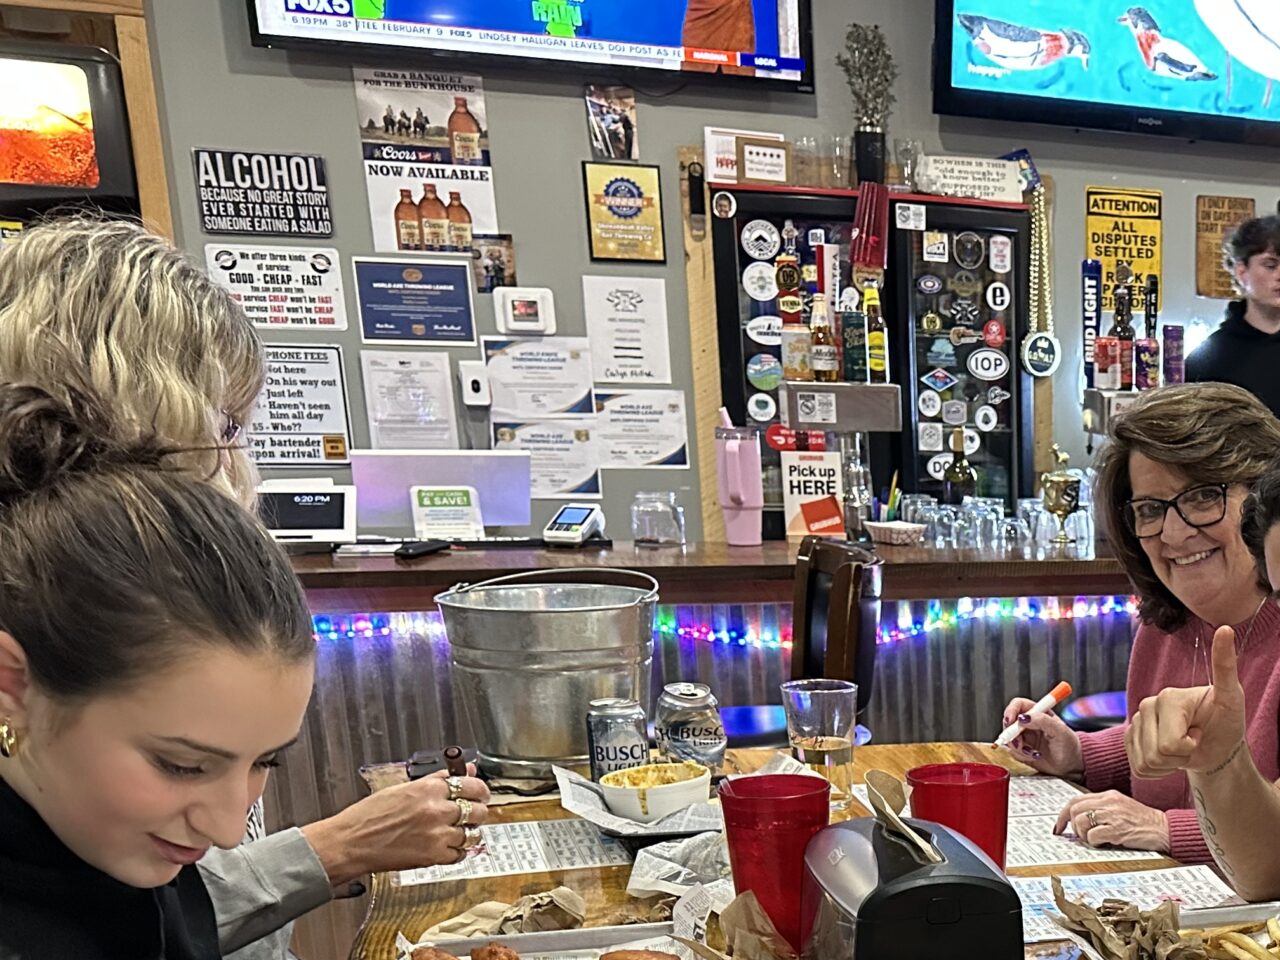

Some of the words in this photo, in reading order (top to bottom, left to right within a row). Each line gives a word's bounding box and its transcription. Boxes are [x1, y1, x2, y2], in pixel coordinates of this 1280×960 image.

[533, 1, 582, 26] RAIN
[382, 24, 431, 35] FEBRUARY
[436, 28, 443, 36] 9
[479, 32, 517, 42] LINDSEY
[522, 36, 567, 47] HALLIGAN
[570, 41, 604, 51] LEAVES
[629, 47, 652, 55] POST
[409, 72, 463, 83] BANQUET
[404, 81, 476, 93] BUNKHOUSE
[381, 146, 417, 160] Coors
[199, 151, 327, 191] ALCOHOL
[368, 165, 404, 177] NOW
[407, 168, 489, 182] AVAILABLE
[200, 187, 246, 201] BECAUSE
[247, 189, 262, 203] NO
[263, 190, 294, 204] GREAT
[296, 192, 327, 206] STORY
[202, 202, 235, 216] EVER
[239, 203, 294, 218] STARTED
[298, 206, 330, 220] WITH
[1091, 198, 1157, 213] ATTENTION
[204, 216, 253, 231] SOMEONE
[254, 219, 289, 232] EATING
[290, 220, 300, 232] A
[300, 220, 332, 234] SALAD
[1111, 221, 1138, 232] ALL
[1091, 232, 1157, 247] DISPUTES
[1094, 246, 1154, 259] SETTLED
[229, 272, 254, 284] GOOD
[263, 273, 292, 285] CHEAP
[302, 275, 323, 286] FAST
[1106, 272, 1143, 283] RK
[1084, 277, 1097, 326] LIGHT
[265, 351, 302, 360] PHONE
[304, 352, 328, 360] FEES
[284, 364, 306, 374] here
[974, 357, 1004, 372] IOP
[265, 377, 281, 386] On
[282, 376, 297, 386] his
[299, 379, 319, 388] way
[321, 379, 336, 387] out
[266, 388, 285, 399] Just
[287, 389, 304, 398] left
[268, 401, 306, 410] Haven't
[269, 411, 290, 420] him
[292, 411, 304, 420] all
[306, 411, 324, 422] day
[271, 422, 302, 432] Who??
[269, 437, 322, 448] bartender
[280, 448, 321, 459] arrival!
[788, 465, 817, 477] Pick
[819, 467, 836, 479] up
[789, 480, 837, 496] HERE
[434, 496, 468, 506] SAVE!
[595, 744, 651, 763] BUSCH
